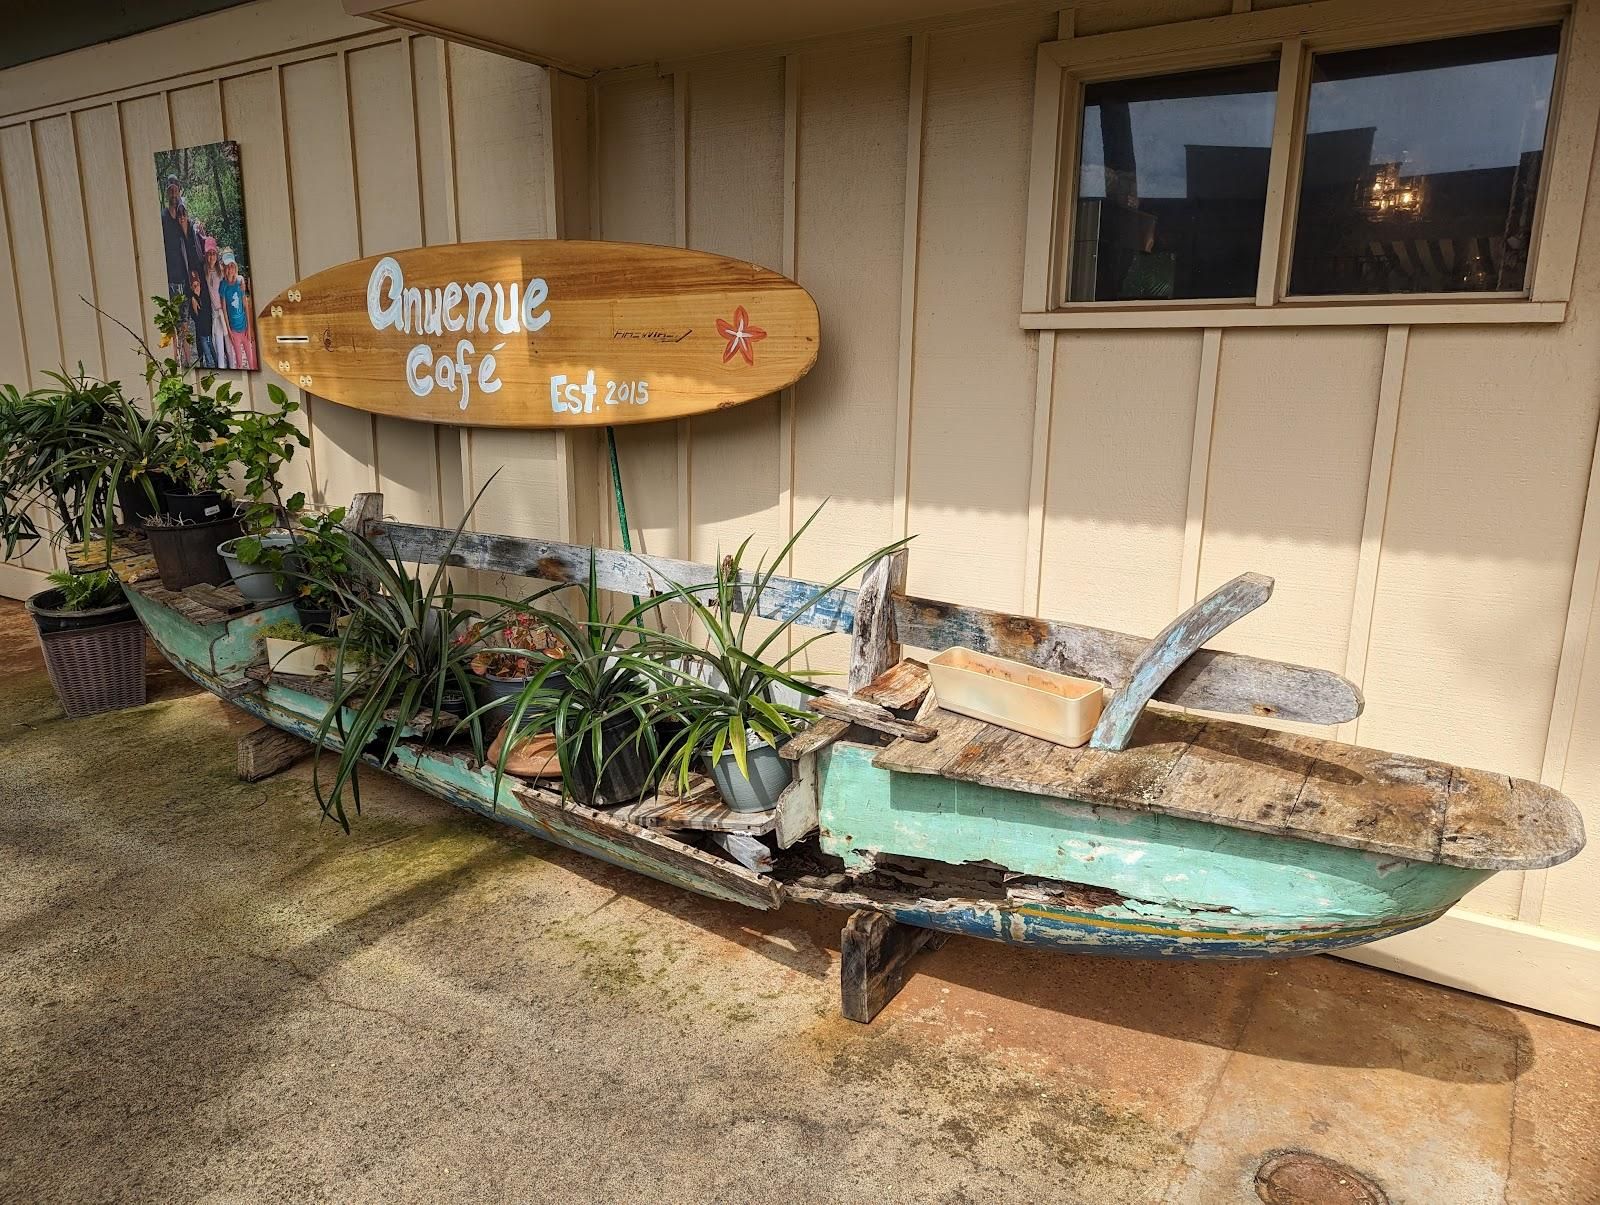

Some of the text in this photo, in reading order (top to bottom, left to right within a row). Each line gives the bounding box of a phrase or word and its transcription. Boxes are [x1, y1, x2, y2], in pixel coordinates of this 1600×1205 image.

[406, 339, 506, 410] Café
[550, 369, 649, 415] Est. 2015
